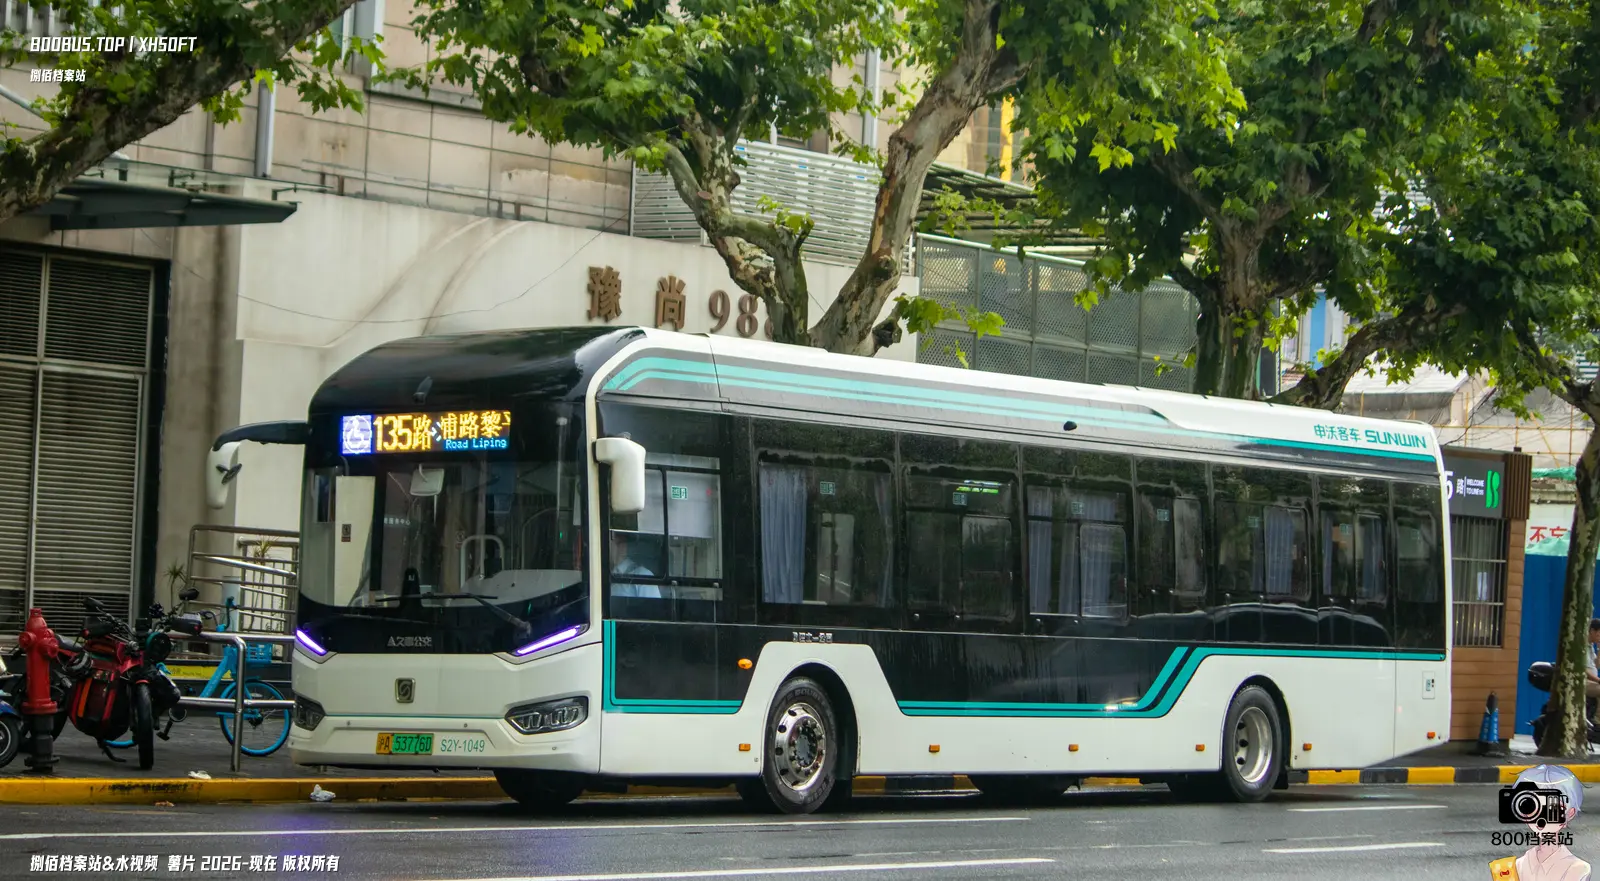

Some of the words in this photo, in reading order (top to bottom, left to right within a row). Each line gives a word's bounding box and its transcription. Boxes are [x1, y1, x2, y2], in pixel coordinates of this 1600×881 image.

[373, 414, 433, 451] 135路
[1313, 423, 1361, 442] 申沃客车
[1364, 429, 1427, 449] SUNWIN
[445, 439, 469, 449] Road
[472, 437, 507, 449] Liping
[440, 738, 486, 752] S2Y-1049
